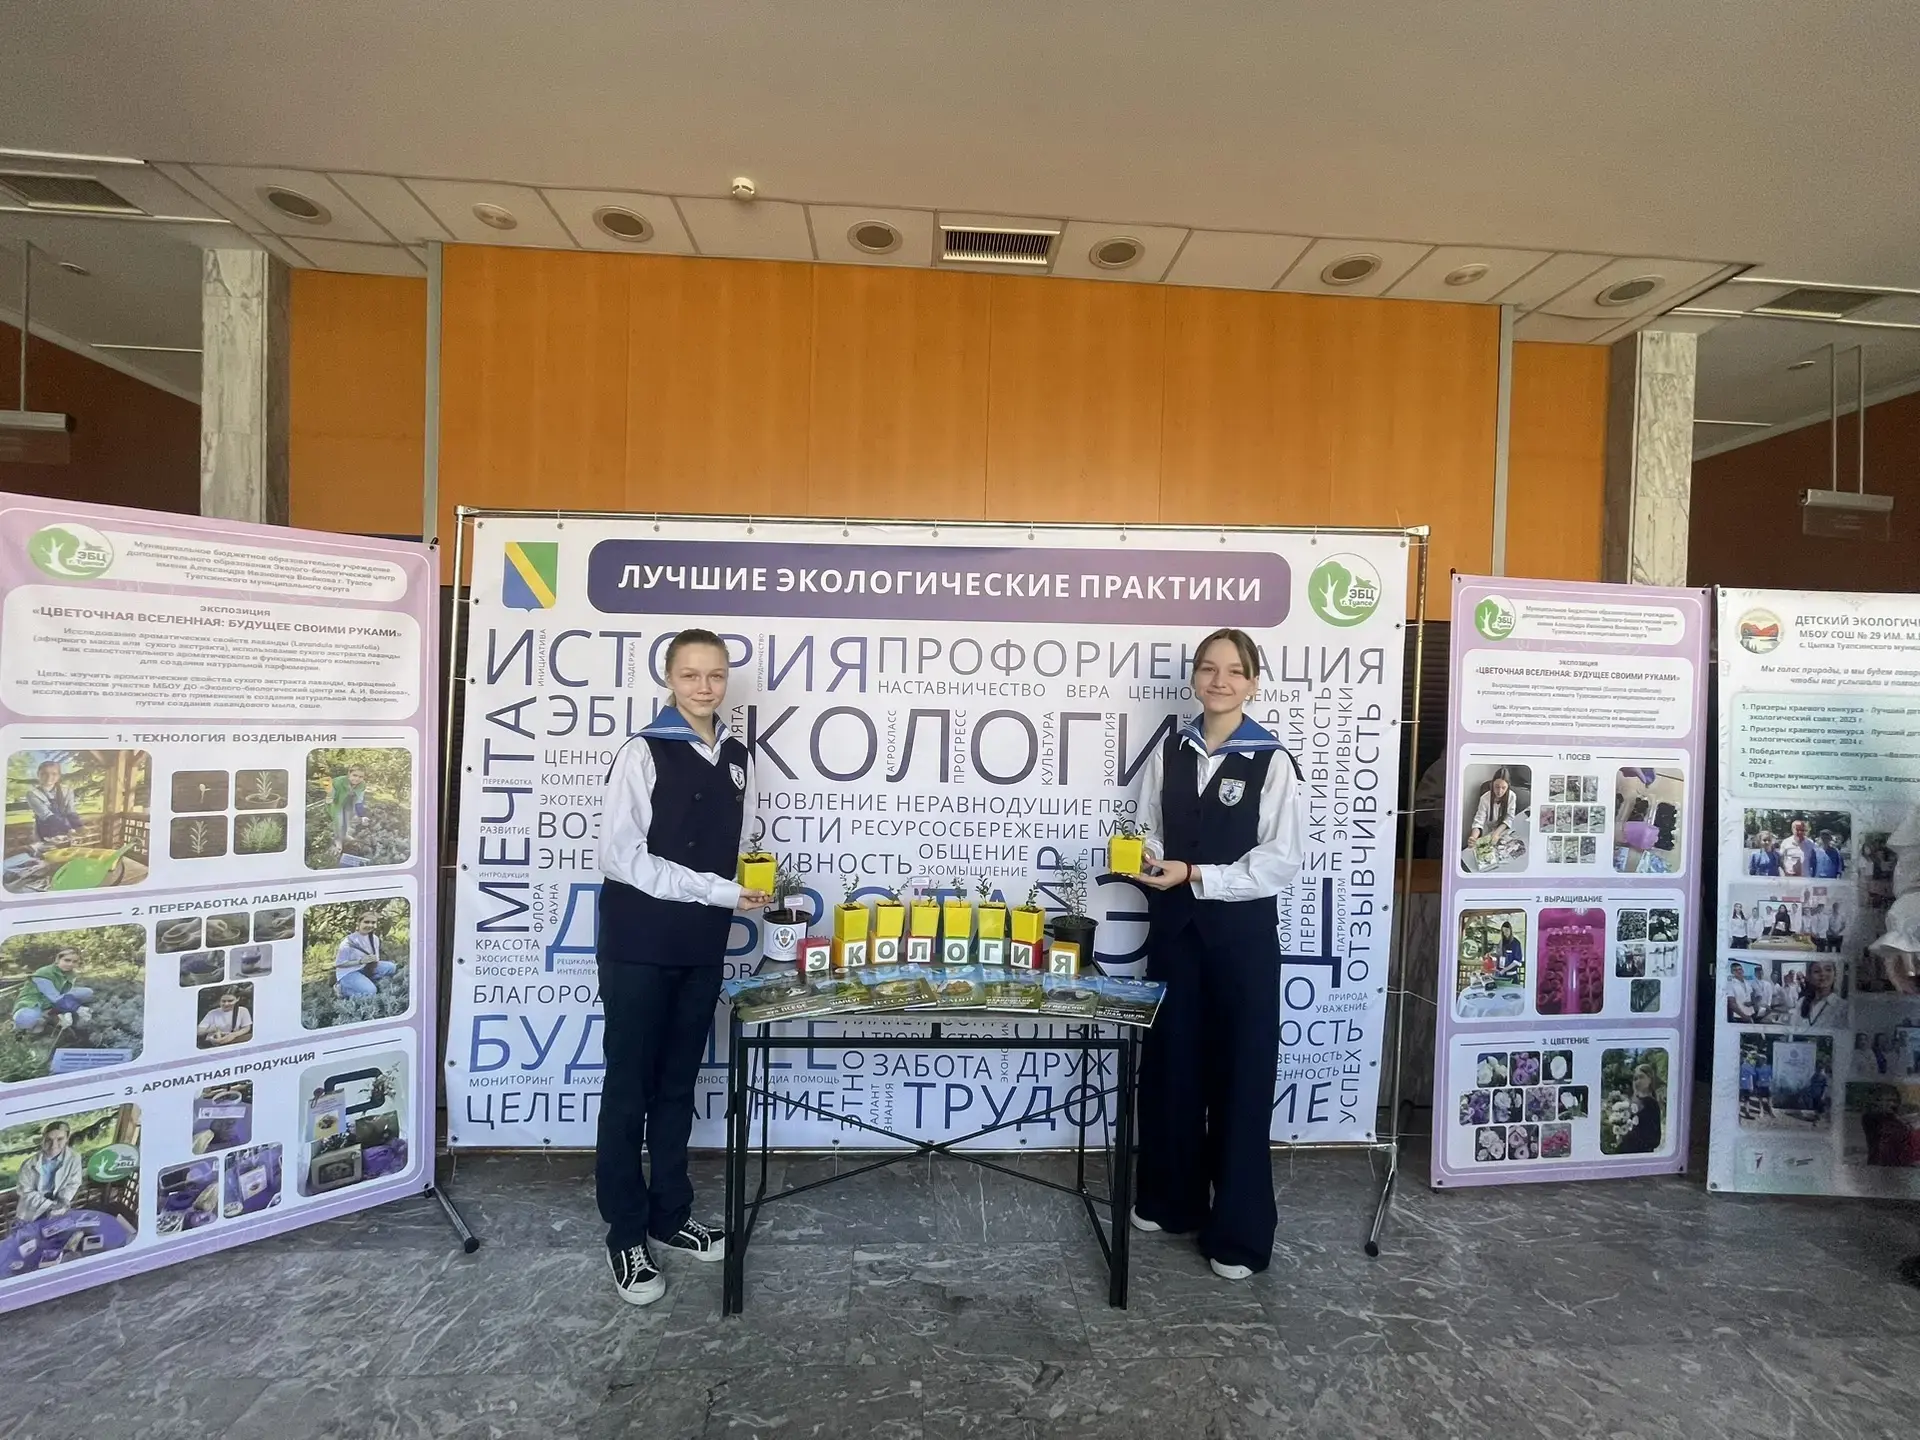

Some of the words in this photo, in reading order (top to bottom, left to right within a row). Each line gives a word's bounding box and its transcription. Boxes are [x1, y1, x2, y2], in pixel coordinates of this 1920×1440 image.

[76, 550, 106, 562] ЭБЦ
[134, 541, 211, 554] Муниципальное
[213, 549, 266, 561] бюджетное
[268, 556, 341, 568] образовательное
[343, 564, 391, 573] учреждение
[214, 558, 271, 569] образования
[156, 562, 187, 570] имени
[190, 564, 246, 575] Александра
[248, 570, 295, 580] Ивановича
[323, 584, 350, 593] округа
[618, 564, 767, 592] ЛУЧШИЕ
[776, 568, 1071, 598] ЭКОЛОГИЧЕСКИЕ
[1080, 574, 1262, 602] ПРАКТИКИ
[1349, 588, 1374, 602] ЭБЦ
[200, 605, 271, 616] ЭКСПОЗИЦИЯ
[32, 606, 134, 622] «ЦВЕТОЧНАЯ
[138, 612, 225, 627] ВСЕЛЕННАЯ:
[228, 619, 292, 632] БУДУЩЕЕ
[294, 623, 346, 634] СВОИМИ
[348, 627, 402, 638] РУКАМИ»
[1795, 614, 1849, 627] ДЕТСКИЙ
[1852, 617, 1920, 627] ЭКОЛОГИЧ
[1800, 630, 1828, 639] МБОУ
[1831, 630, 1854, 639] СОШ
[1857, 632, 1868, 640] №
[1870, 632, 1880, 640] 29
[1884, 632, 1904, 640] ИМ.
[1808, 642, 1834, 650] Цыпка
[1837, 642, 1892, 651] Туапсинского
[537, 628, 548, 688] ИНИЦИАТИВА
[627, 641, 636, 688] ПОДДЕРЖКА
[756, 633, 765, 692] СОТРУДНИЧЕСТВО
[878, 636, 1384, 692] ПРОФОРИЕНАЦИЯ
[1475, 666, 1524, 676] «ЦВЕТОЧНАЯ
[1525, 668, 1571, 678] ВСЕЛЕННАЯ:
[1573, 670, 1609, 680] БУДУЩЕЕ
[1610, 672, 1643, 680] СВОИМИ
[1644, 673, 1680, 682] РУКАМИ»
[1761, 665, 1776, 673] Мы
[878, 680, 1046, 698] НАСТАВНИЧЕСТВО
[1066, 684, 1110, 700] ВЕРА
[1750, 704, 1787, 712] Призеры
[1750, 714, 1811, 722] экологический
[1750, 725, 1787, 734] Призеры
[116, 733, 128, 743] 1.
[134, 734, 226, 744] ТЕХНОЛОГИЯ
[232, 732, 338, 745] ВОЗДЕЛЫВАНИЯ
[746, 703, 1178, 787] КОЛОГИ
[886, 710, 897, 772] АГРОКЛАСС
[953, 709, 967, 784] ПРОГРЕСС
[1750, 736, 1811, 744] экологический
[1041, 711, 1054, 786] КУЛЬТУРА
[1104, 712, 1116, 786] ЭКОЛОГИЯ
[1750, 748, 1800, 756] Победители
[1333, 688, 1354, 840] ЭКОПРИВЫЧКИ
[1558, 753, 1564, 761] 1.
[1566, 752, 1591, 762] ПОСЕВ
[1308, 687, 1332, 844] АКТИВНОСТЬ
[482, 778, 532, 786] ПЕРЕРАБОТКА
[1749, 772, 1786, 780] Призеры
[476, 696, 538, 932] МЕЧТА
[896, 794, 1092, 818] НЕРАВНОДУШИЕ
[480, 826, 530, 836] РАЗВИТИЕ
[852, 820, 1089, 840] РЕСУРСОСБЕРЕЖЕНИЕ
[1348, 704, 1381, 982] ОТЗЫВЧИВОСТЬ
[918, 843, 1029, 864] ОБЩЕНИЕ
[478, 872, 530, 880] ИНТРОДУКЦИЯ
[918, 864, 1028, 878] ЭКОМЫШЛЕНИЕ
[132, 906, 144, 916] 2.
[148, 897, 249, 916] ПЕРЕРАБОТКА
[252, 890, 318, 907] ЛАВАНДЫ
[548, 883, 559, 924] ФАУНА
[1544, 894, 1603, 904] ВЫРАЩИВАНИЕ
[532, 883, 544, 933] ФЛОРА
[1300, 876, 1316, 952] ПЕРВЫЕ
[1336, 878, 1346, 952] ПАТРИОТИЗМ
[1280, 883, 1295, 952] КОМАНД
[476, 939, 540, 950] КРАСОТА
[476, 954, 540, 964] ЭКОСИСТЕМА
[556, 958, 598, 966] РЕЦИКЛИН
[475, 966, 540, 977] БИОСФЕРА
[556, 968, 599, 976] ИНТЕЛЛЕК
[1328, 992, 1368, 1002] ПРИРОДА
[1315, 1002, 1368, 1014] УВАЖЕНИЕ
[1542, 1038, 1548, 1046] 3.
[1550, 1036, 1590, 1047] ЦВЕТЕНИЕ
[124, 1085, 138, 1096] 3.
[142, 1068, 231, 1093] АРОМАТНАЯ
[234, 1052, 316, 1076] ПРОДУКЦИЯ
[872, 1053, 992, 1080] ЗАБОТА
[469, 1075, 554, 1087] МОНИТОРИНГ
[754, 1075, 789, 1085] МДИА
[794, 1074, 840, 1085] ПОМОЩЬ
[1339, 1049, 1362, 1124] УСПЕХ
[870, 1084, 880, 1125] АЛАНТ
[884, 1083, 894, 1132] ЗНАНИЯ
